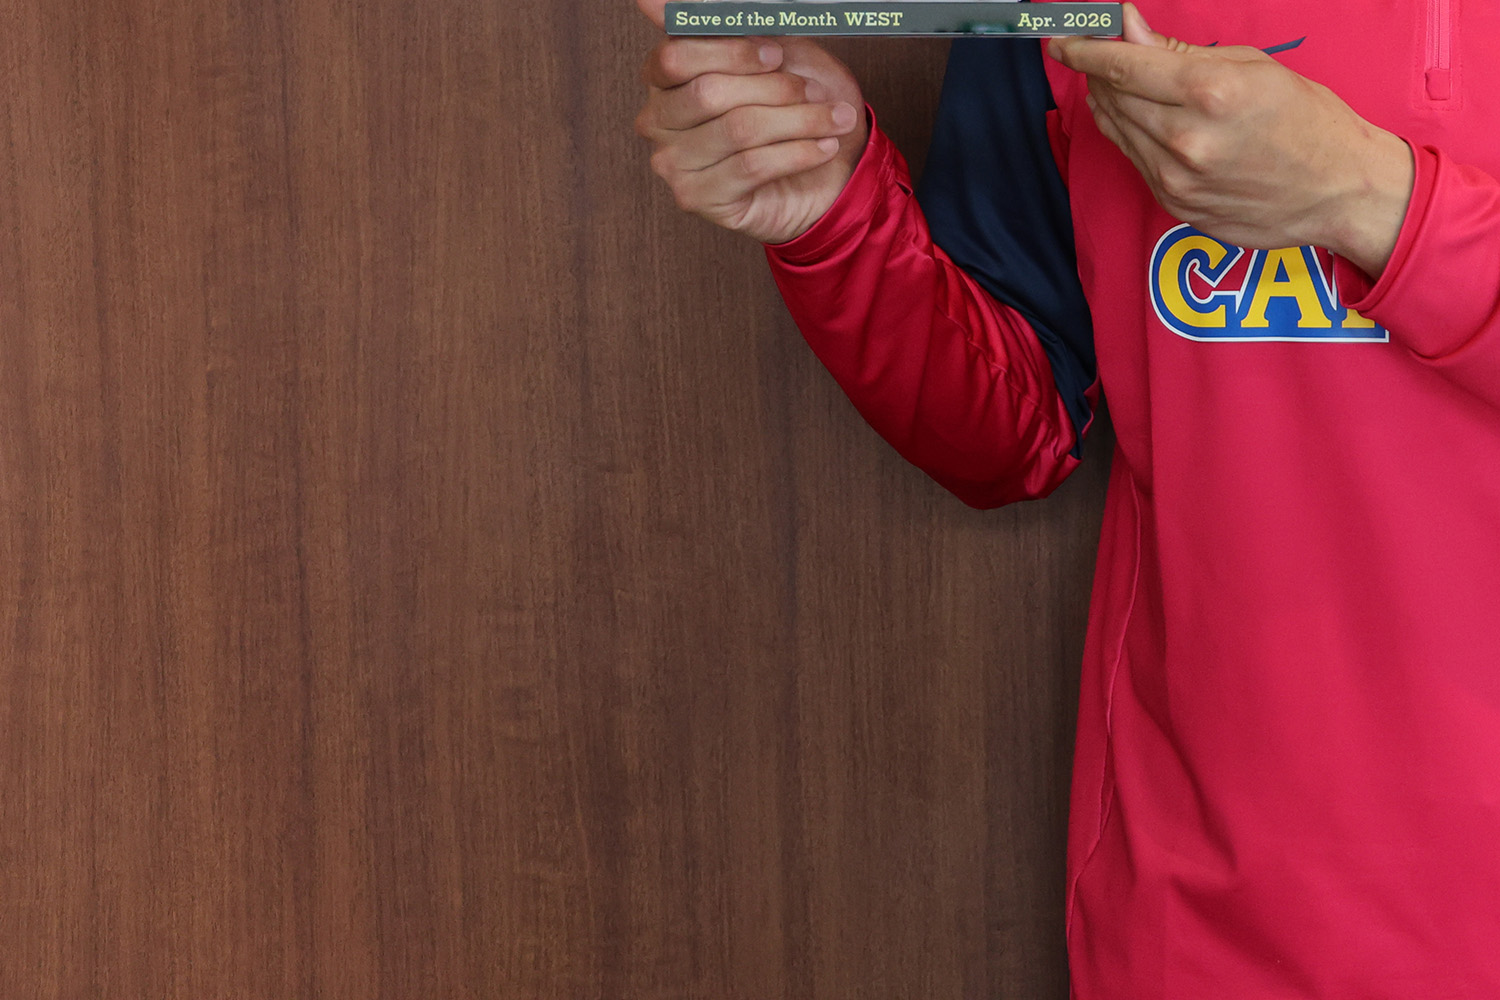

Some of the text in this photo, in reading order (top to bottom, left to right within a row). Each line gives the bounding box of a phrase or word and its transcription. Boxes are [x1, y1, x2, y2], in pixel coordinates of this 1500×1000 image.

[675, 11, 903, 26] Save of the Month WEST
[1017, 12, 1112, 31] Apr. 2026
